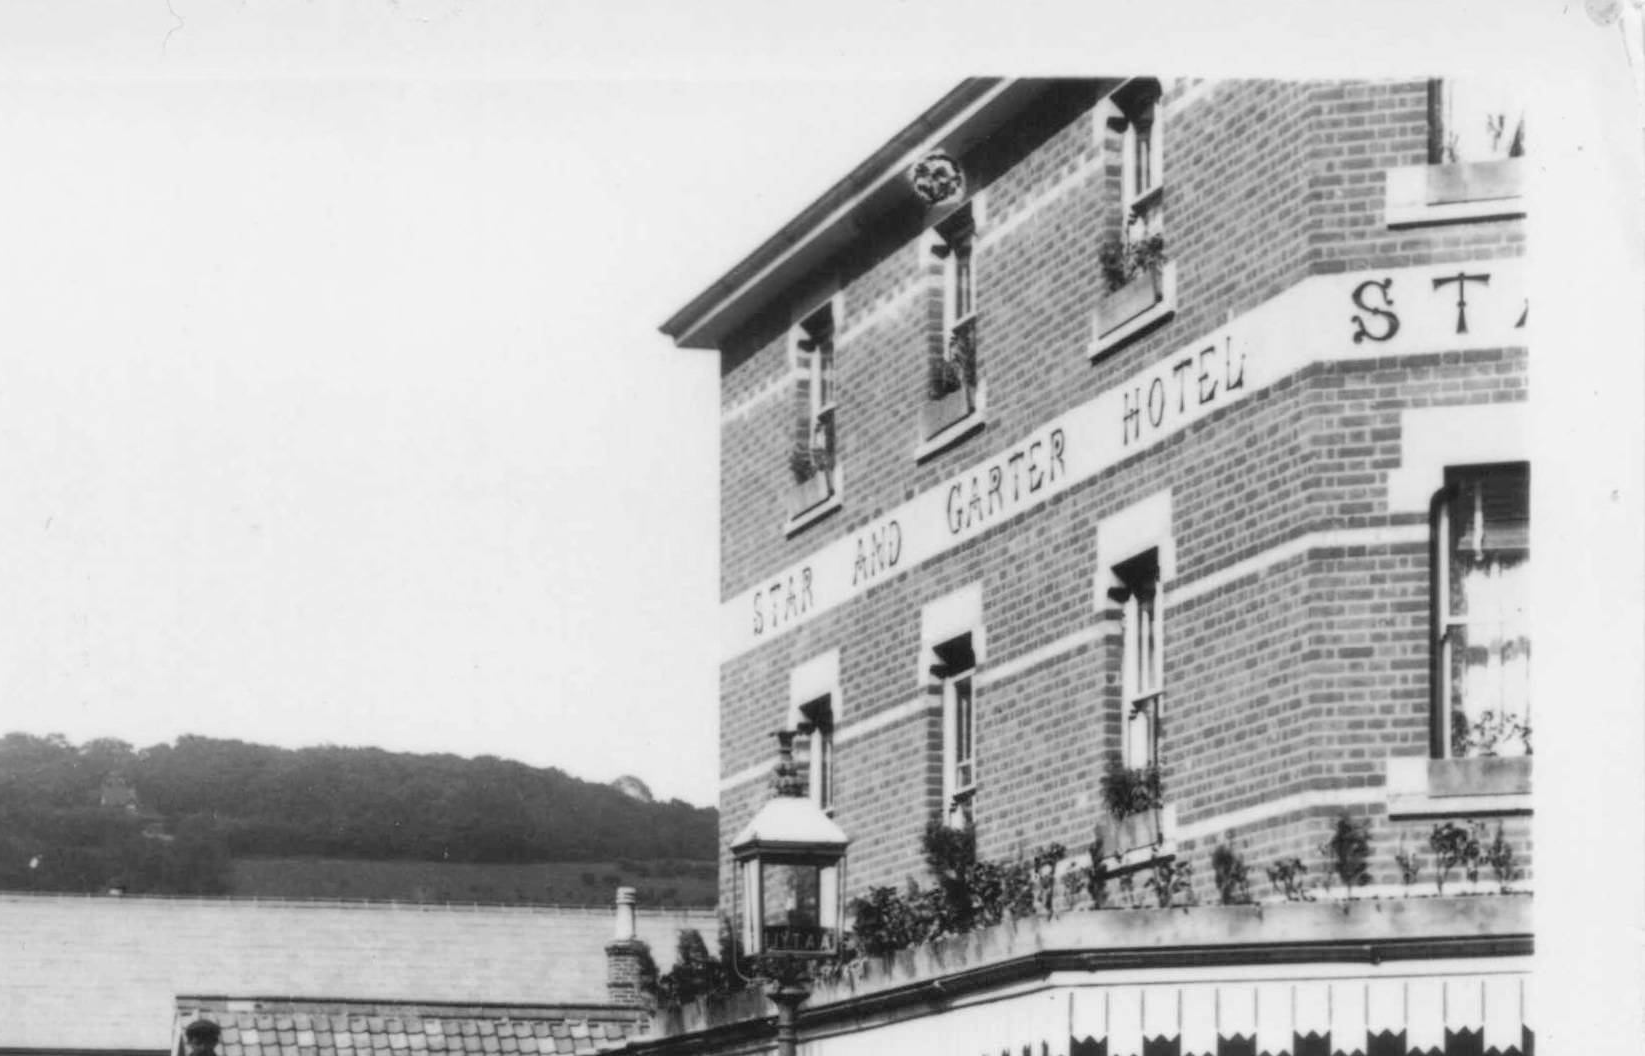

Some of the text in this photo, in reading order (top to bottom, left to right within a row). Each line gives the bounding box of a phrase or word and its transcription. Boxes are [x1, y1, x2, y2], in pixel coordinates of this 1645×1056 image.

[753, 335, 1247, 637] STAR AND GARTER HOTEL
